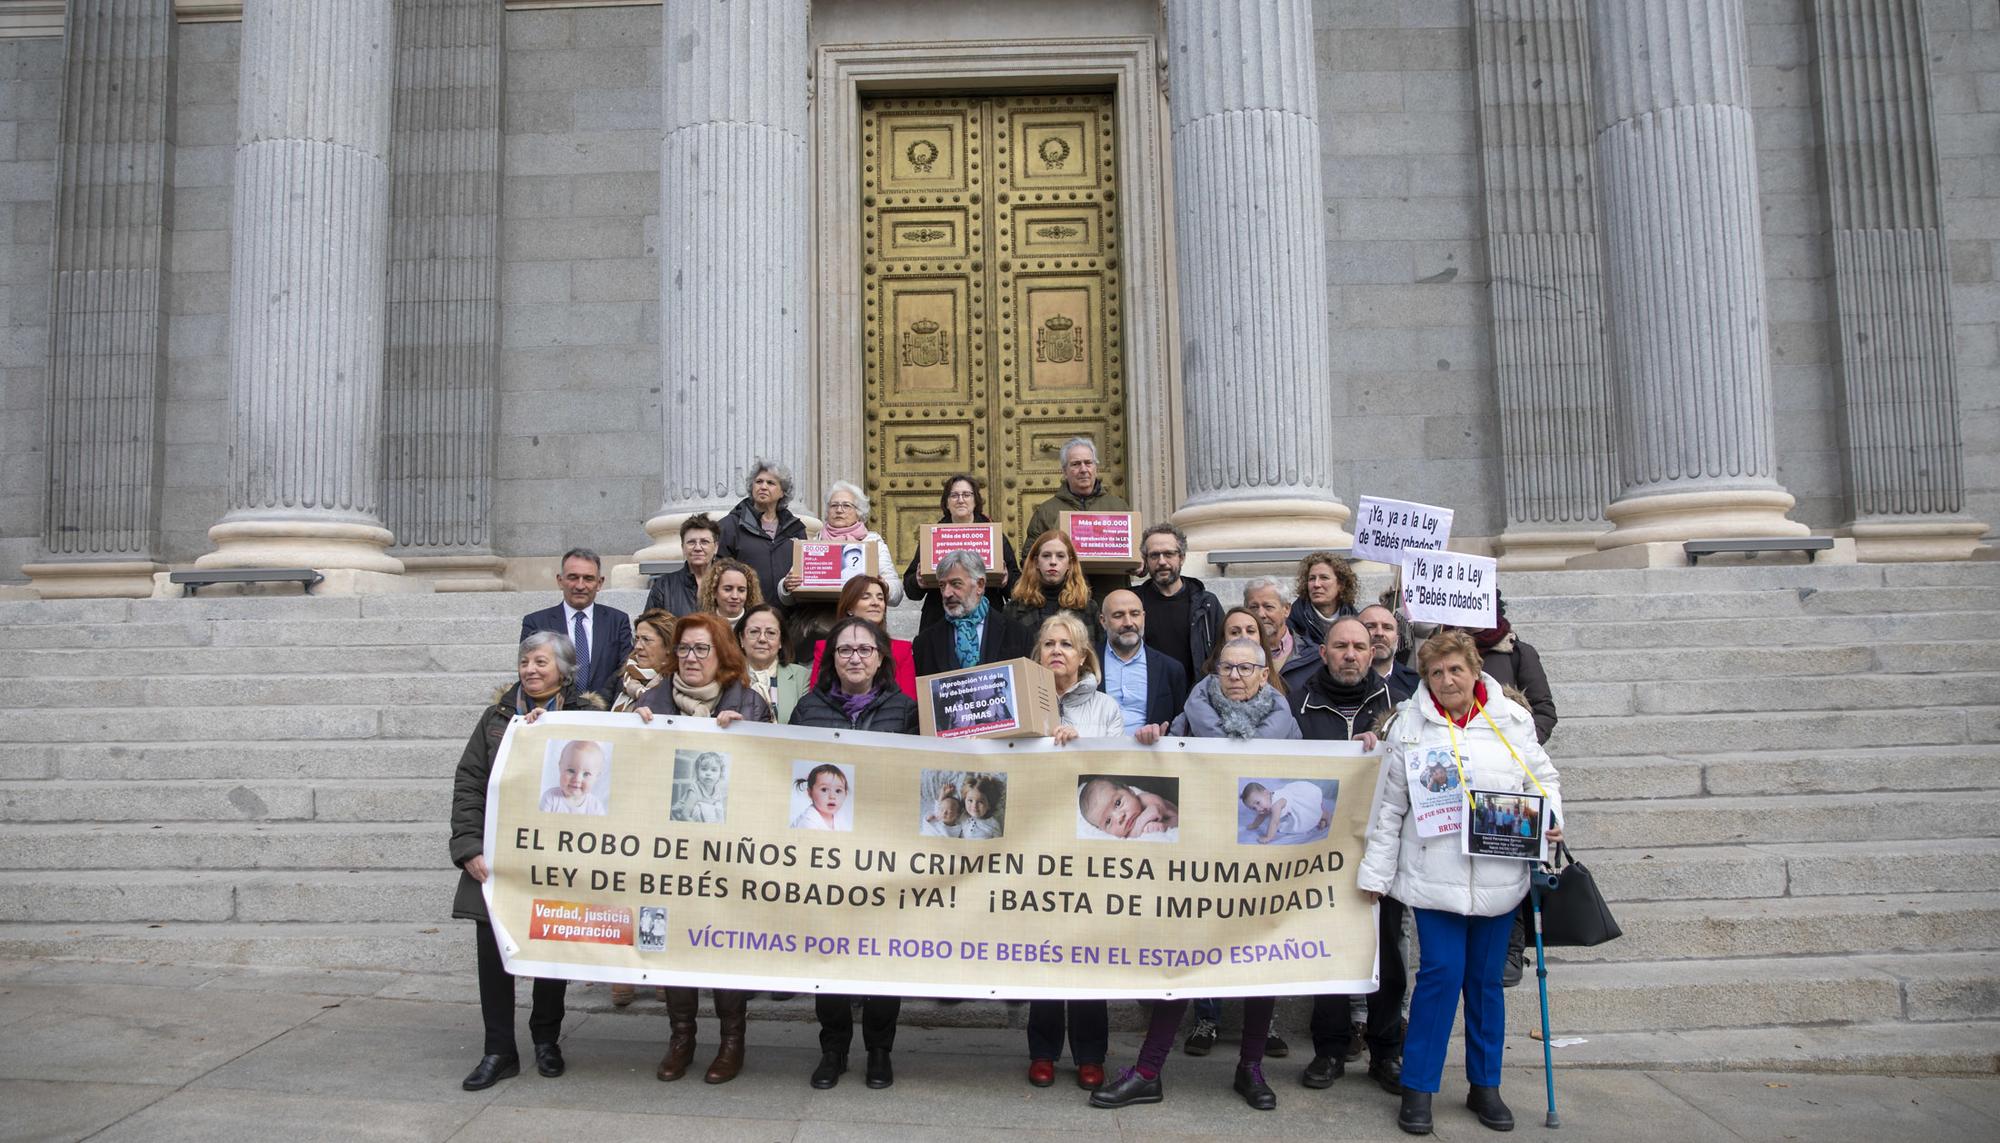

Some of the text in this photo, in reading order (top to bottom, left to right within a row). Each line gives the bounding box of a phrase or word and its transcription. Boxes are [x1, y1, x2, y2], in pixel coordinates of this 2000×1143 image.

[1368, 504, 1439, 535] ¡Ya, ya a la Ley
[1358, 528, 1369, 544] de
[1371, 529, 1400, 549] "Bebés
[1411, 558, 1483, 588] ¡Ya, ya a la Ley
[1404, 584, 1490, 611] de "Bebés robados"!
[939, 691, 949, 699] ley
[958, 686, 977, 695] bebés
[944, 696, 1007, 714] MÁS DE 80.000
[961, 710, 992, 722] FIRMAS
[515, 827, 1344, 883] EL ROBO DE NIÑOS ES UN CRIMEN DE LESA HUMANIDAD
[531, 865, 1335, 918] LEY DE BEBÉS ROBADOS ¡YA! ¡BASTA DE IMPUNIDAD!
[535, 903, 630, 924] Verdad, justicia
[542, 922, 621, 939] y reparación
[687, 924, 1331, 967] VÍCTIMAS POR EL ROBO DE BEBÉS EN EL ESTADO ESPAÑOL
